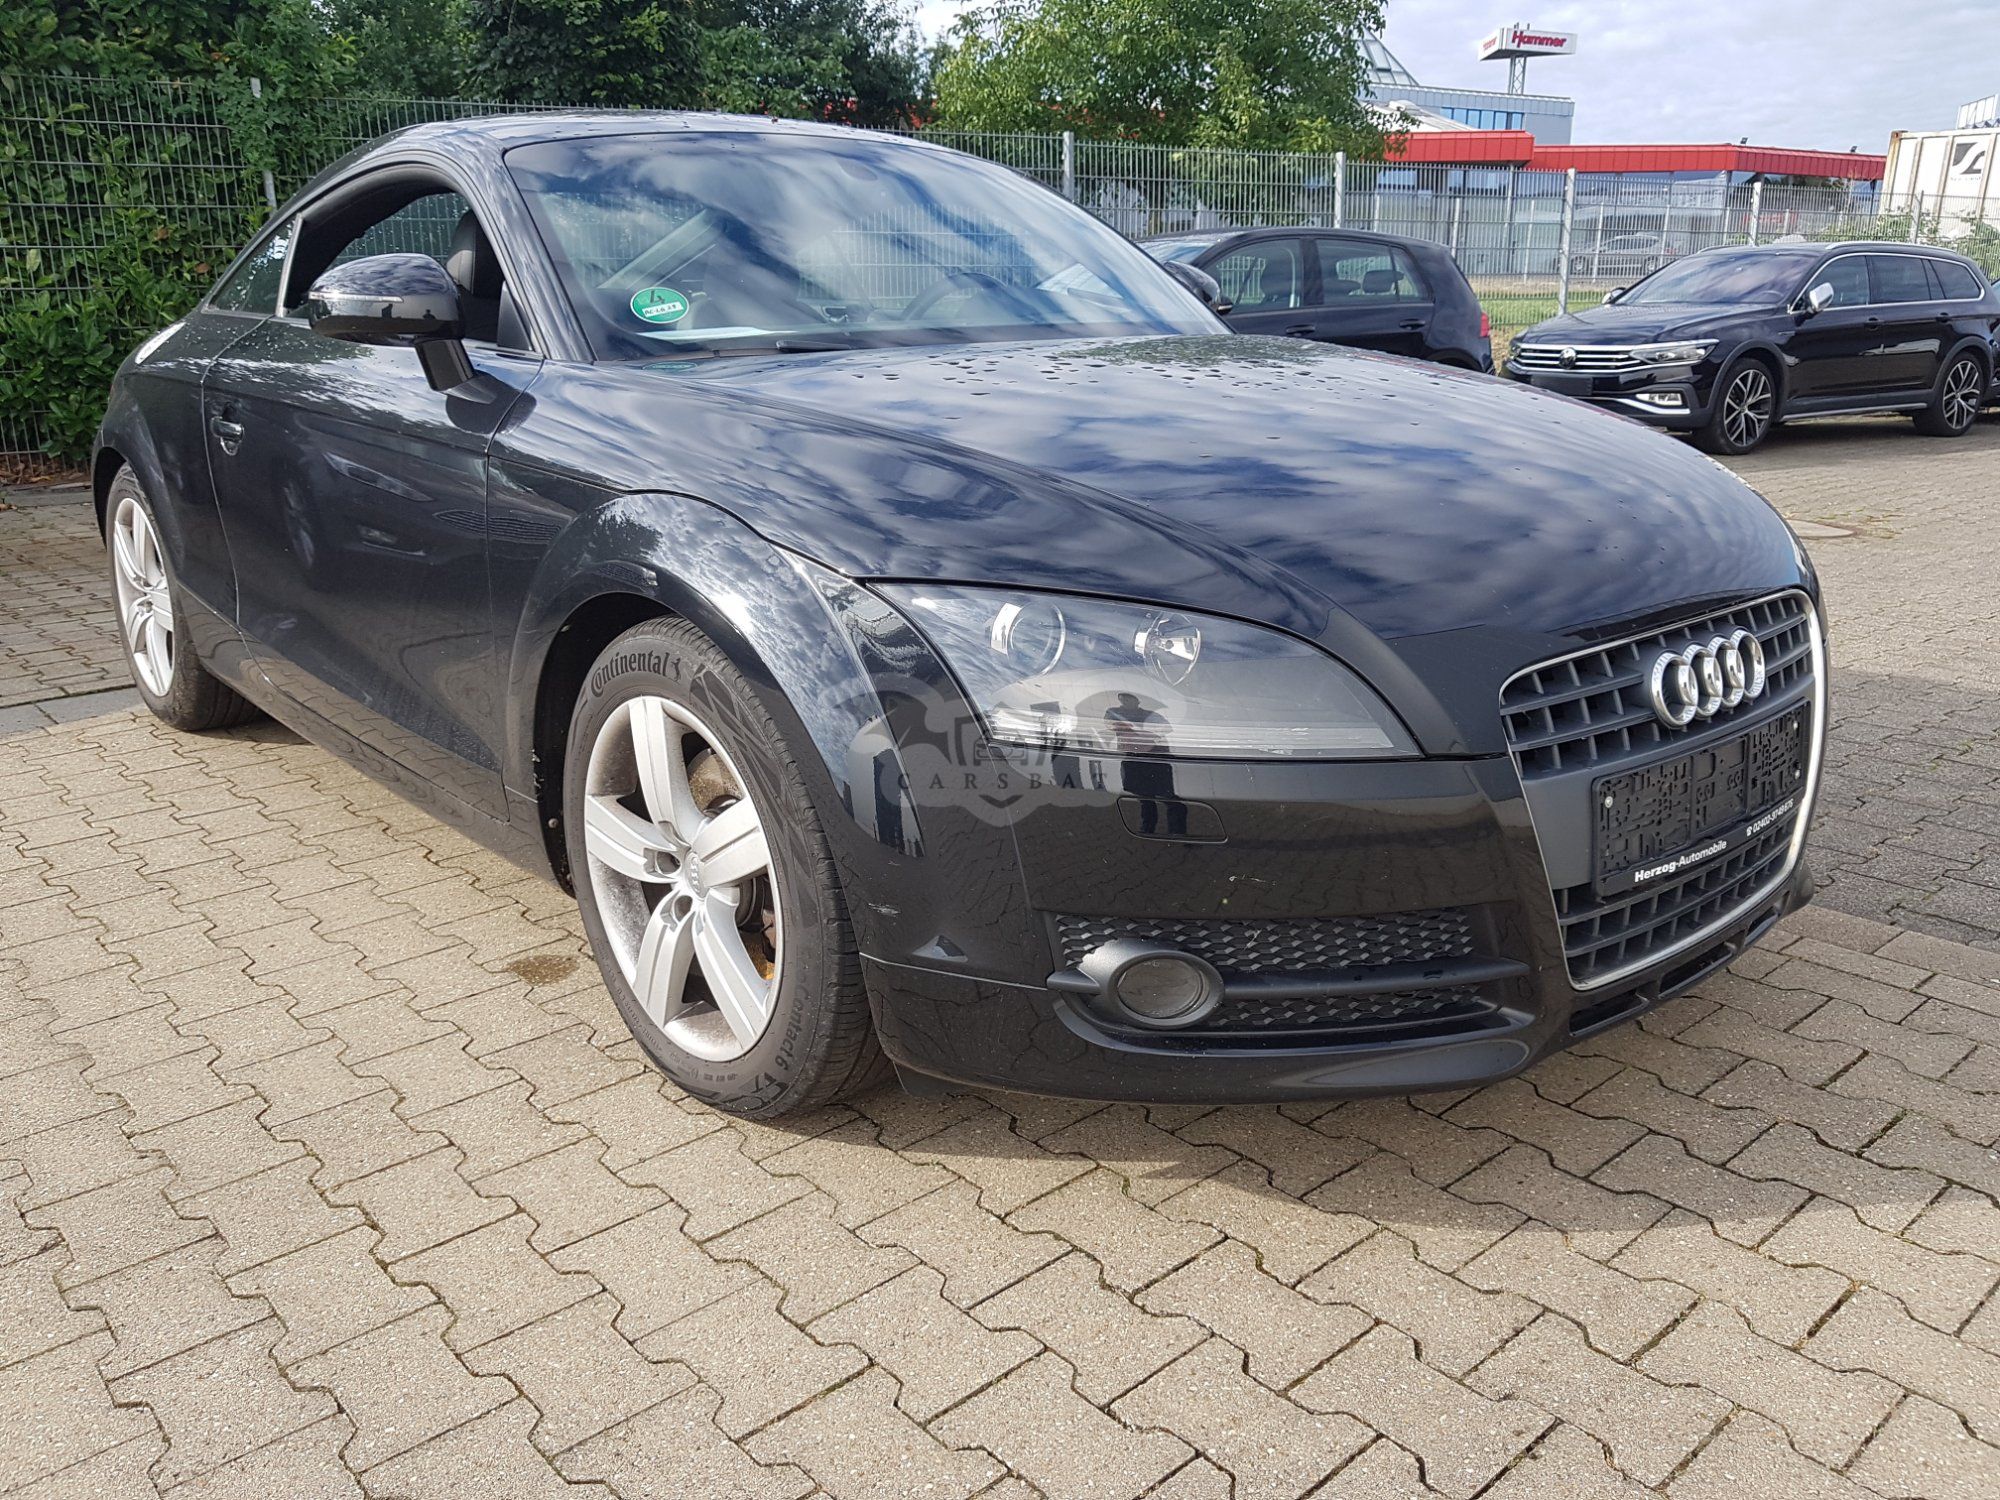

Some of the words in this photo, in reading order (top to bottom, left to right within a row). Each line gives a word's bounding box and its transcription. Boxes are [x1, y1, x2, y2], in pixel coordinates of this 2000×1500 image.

[1511, 30, 1567, 48] Hammer
[591, 650, 671, 698] Continental
[1634, 839, 1727, 883] Herzog-Automobile
